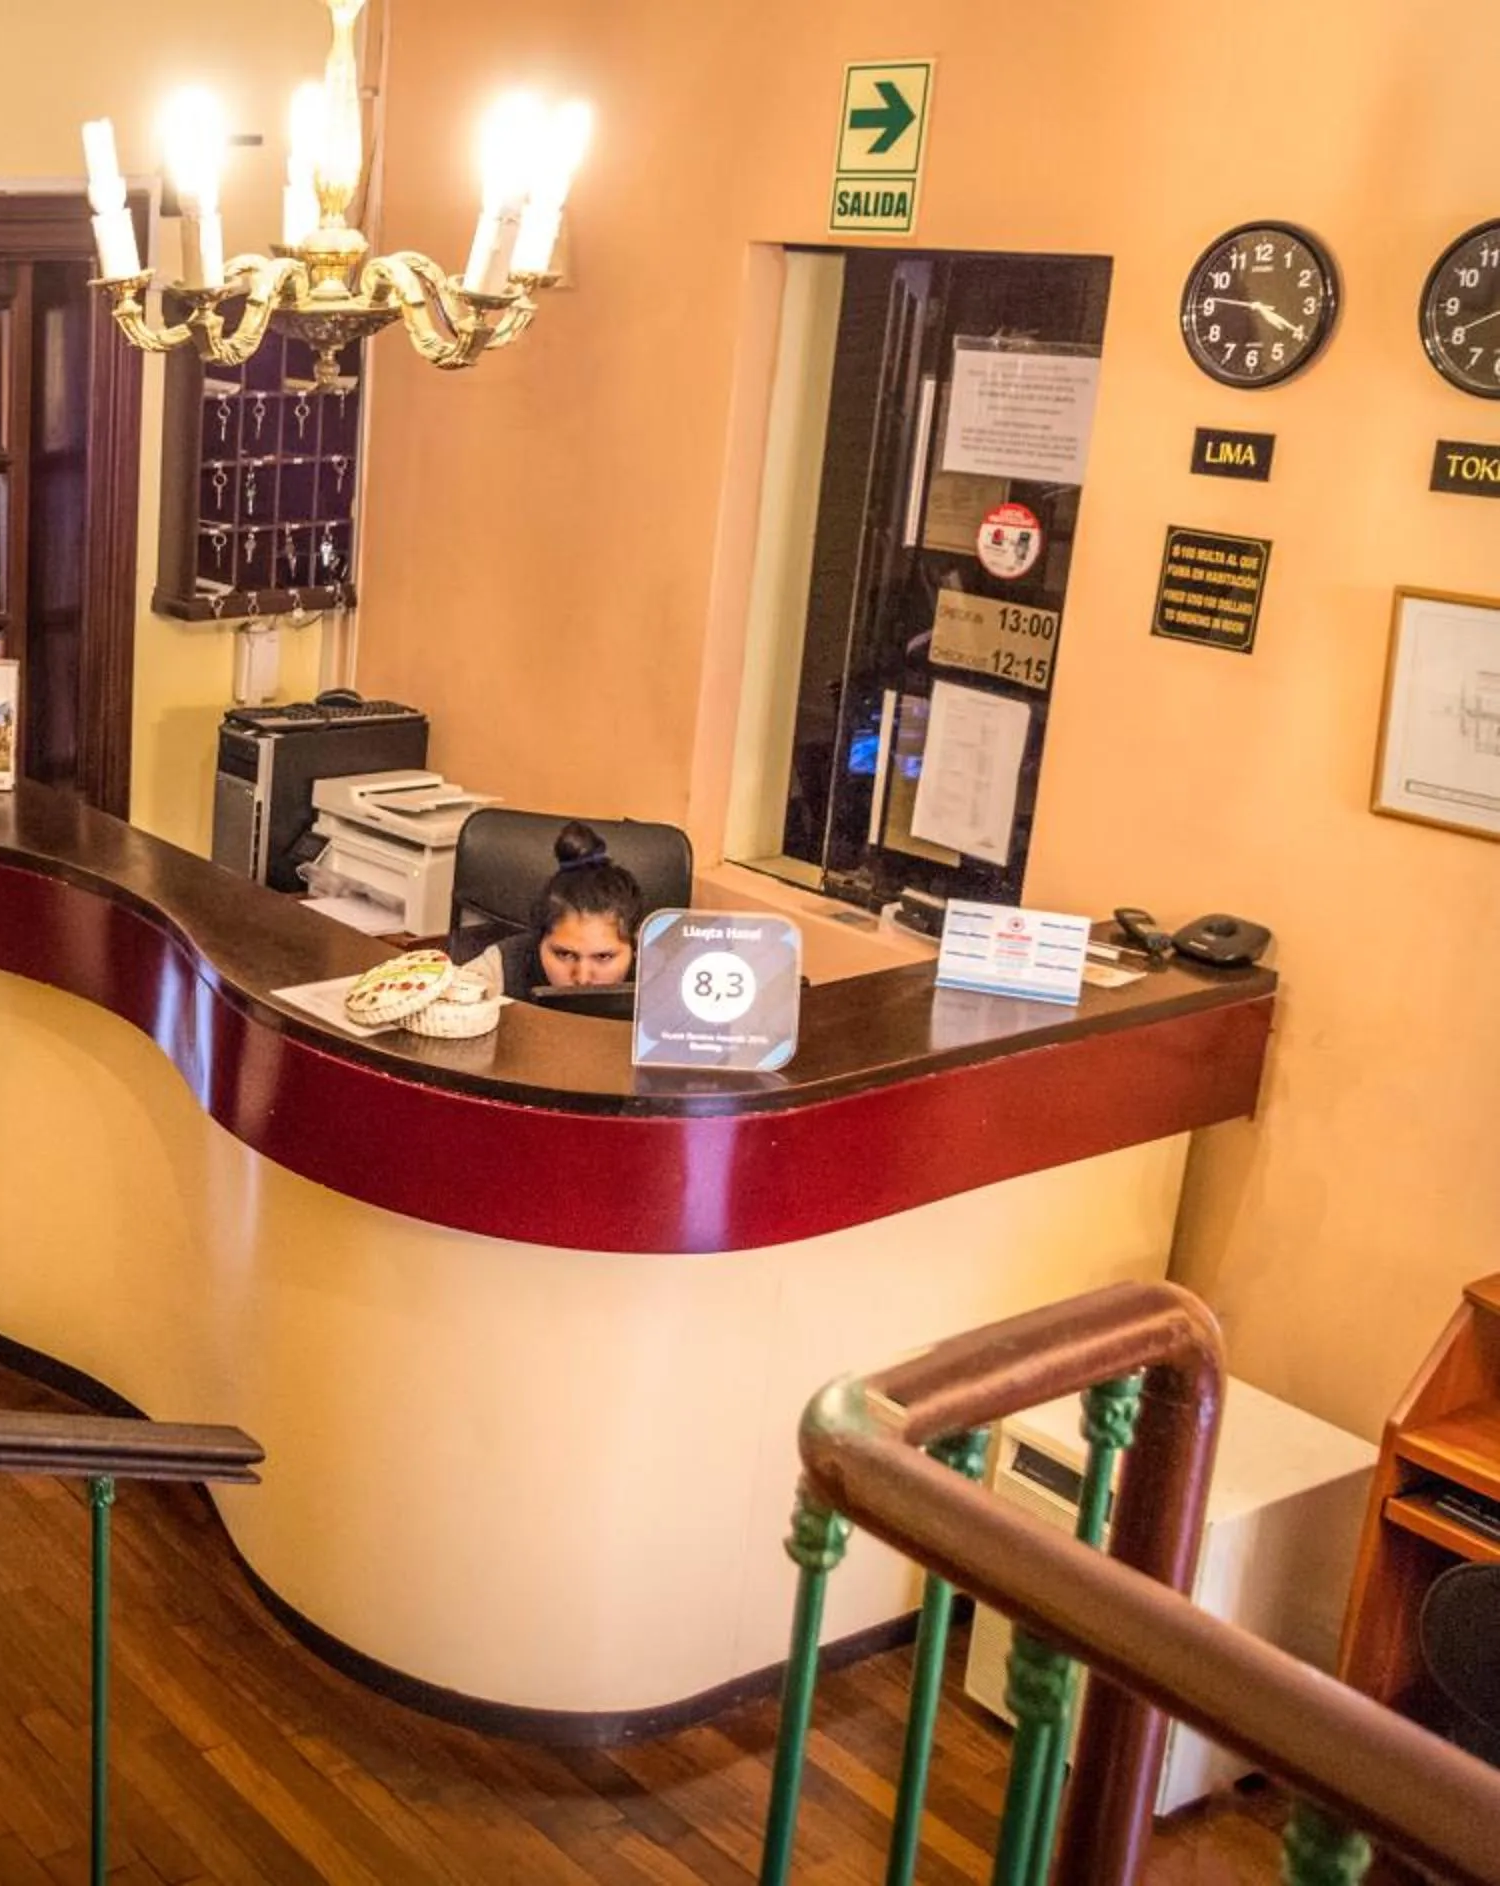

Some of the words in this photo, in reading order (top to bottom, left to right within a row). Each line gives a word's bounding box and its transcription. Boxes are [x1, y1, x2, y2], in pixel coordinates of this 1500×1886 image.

[837, 190, 907, 218] SALIDA
[1231, 252, 1247, 270] 11
[1254, 243, 1274, 262] 12
[1284, 251, 1293, 268] 1
[1480, 249, 1500, 268] 11
[1211, 271, 1231, 289] 10
[1298, 270, 1311, 288] 2
[1458, 269, 1479, 288] 10
[1203, 299, 1215, 317] 9
[1303, 298, 1315, 315] 3
[1446, 297, 1460, 317] 9
[1209, 325, 1221, 343] 8
[1452, 326, 1465, 345] 8
[1225, 343, 1236, 361] 7
[1245, 350, 1259, 367] 6
[1271, 343, 1285, 361] 5
[1469, 347, 1483, 366] 7
[1205, 440, 1256, 466] LIMA
[1447, 454, 1500, 482] TOK
[999, 607, 1054, 640] 13:00
[992, 649, 1046, 683] 12:15
[694, 970, 744, 1002] 8,3
